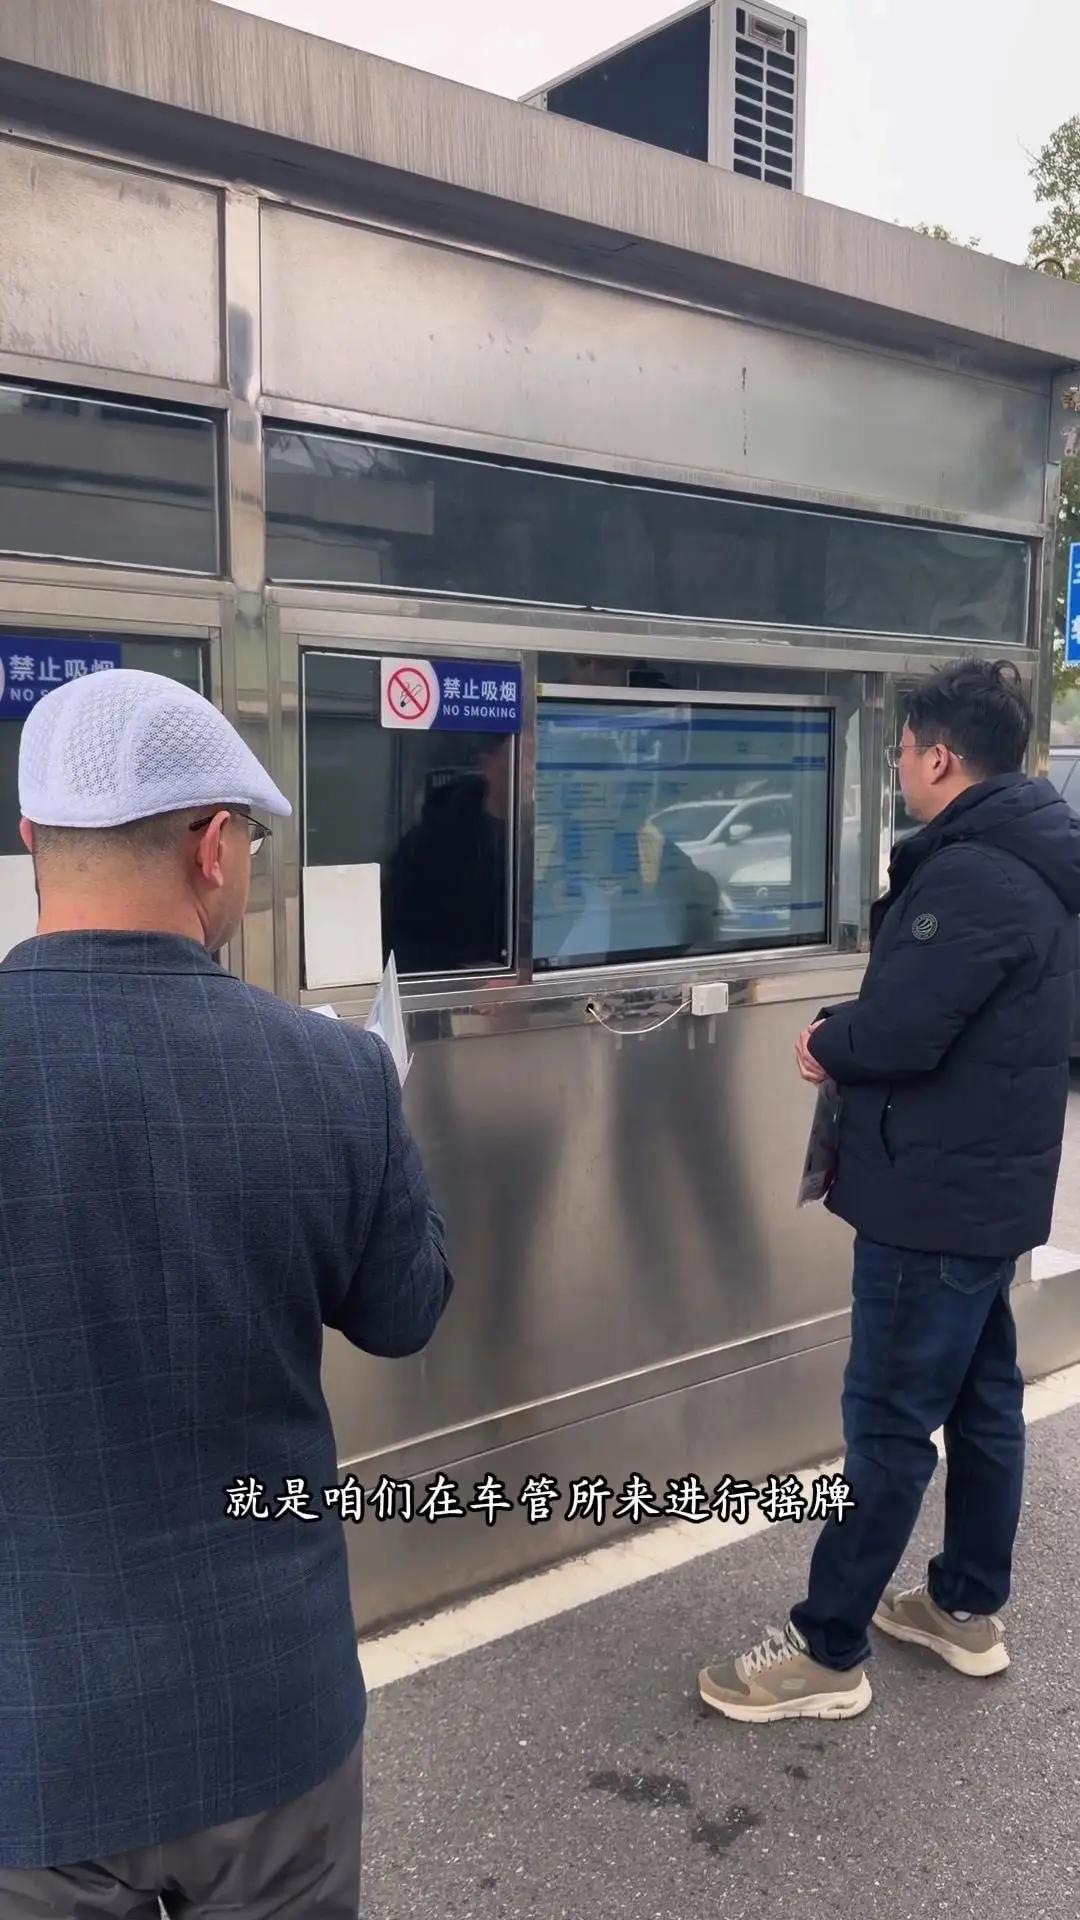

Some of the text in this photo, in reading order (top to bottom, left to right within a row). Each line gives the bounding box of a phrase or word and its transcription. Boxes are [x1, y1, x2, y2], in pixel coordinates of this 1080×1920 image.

[10, 688, 34, 701] NO
[443, 677, 516, 702] 禁止吸烟
[443, 704, 516, 718] NO SMOKING
